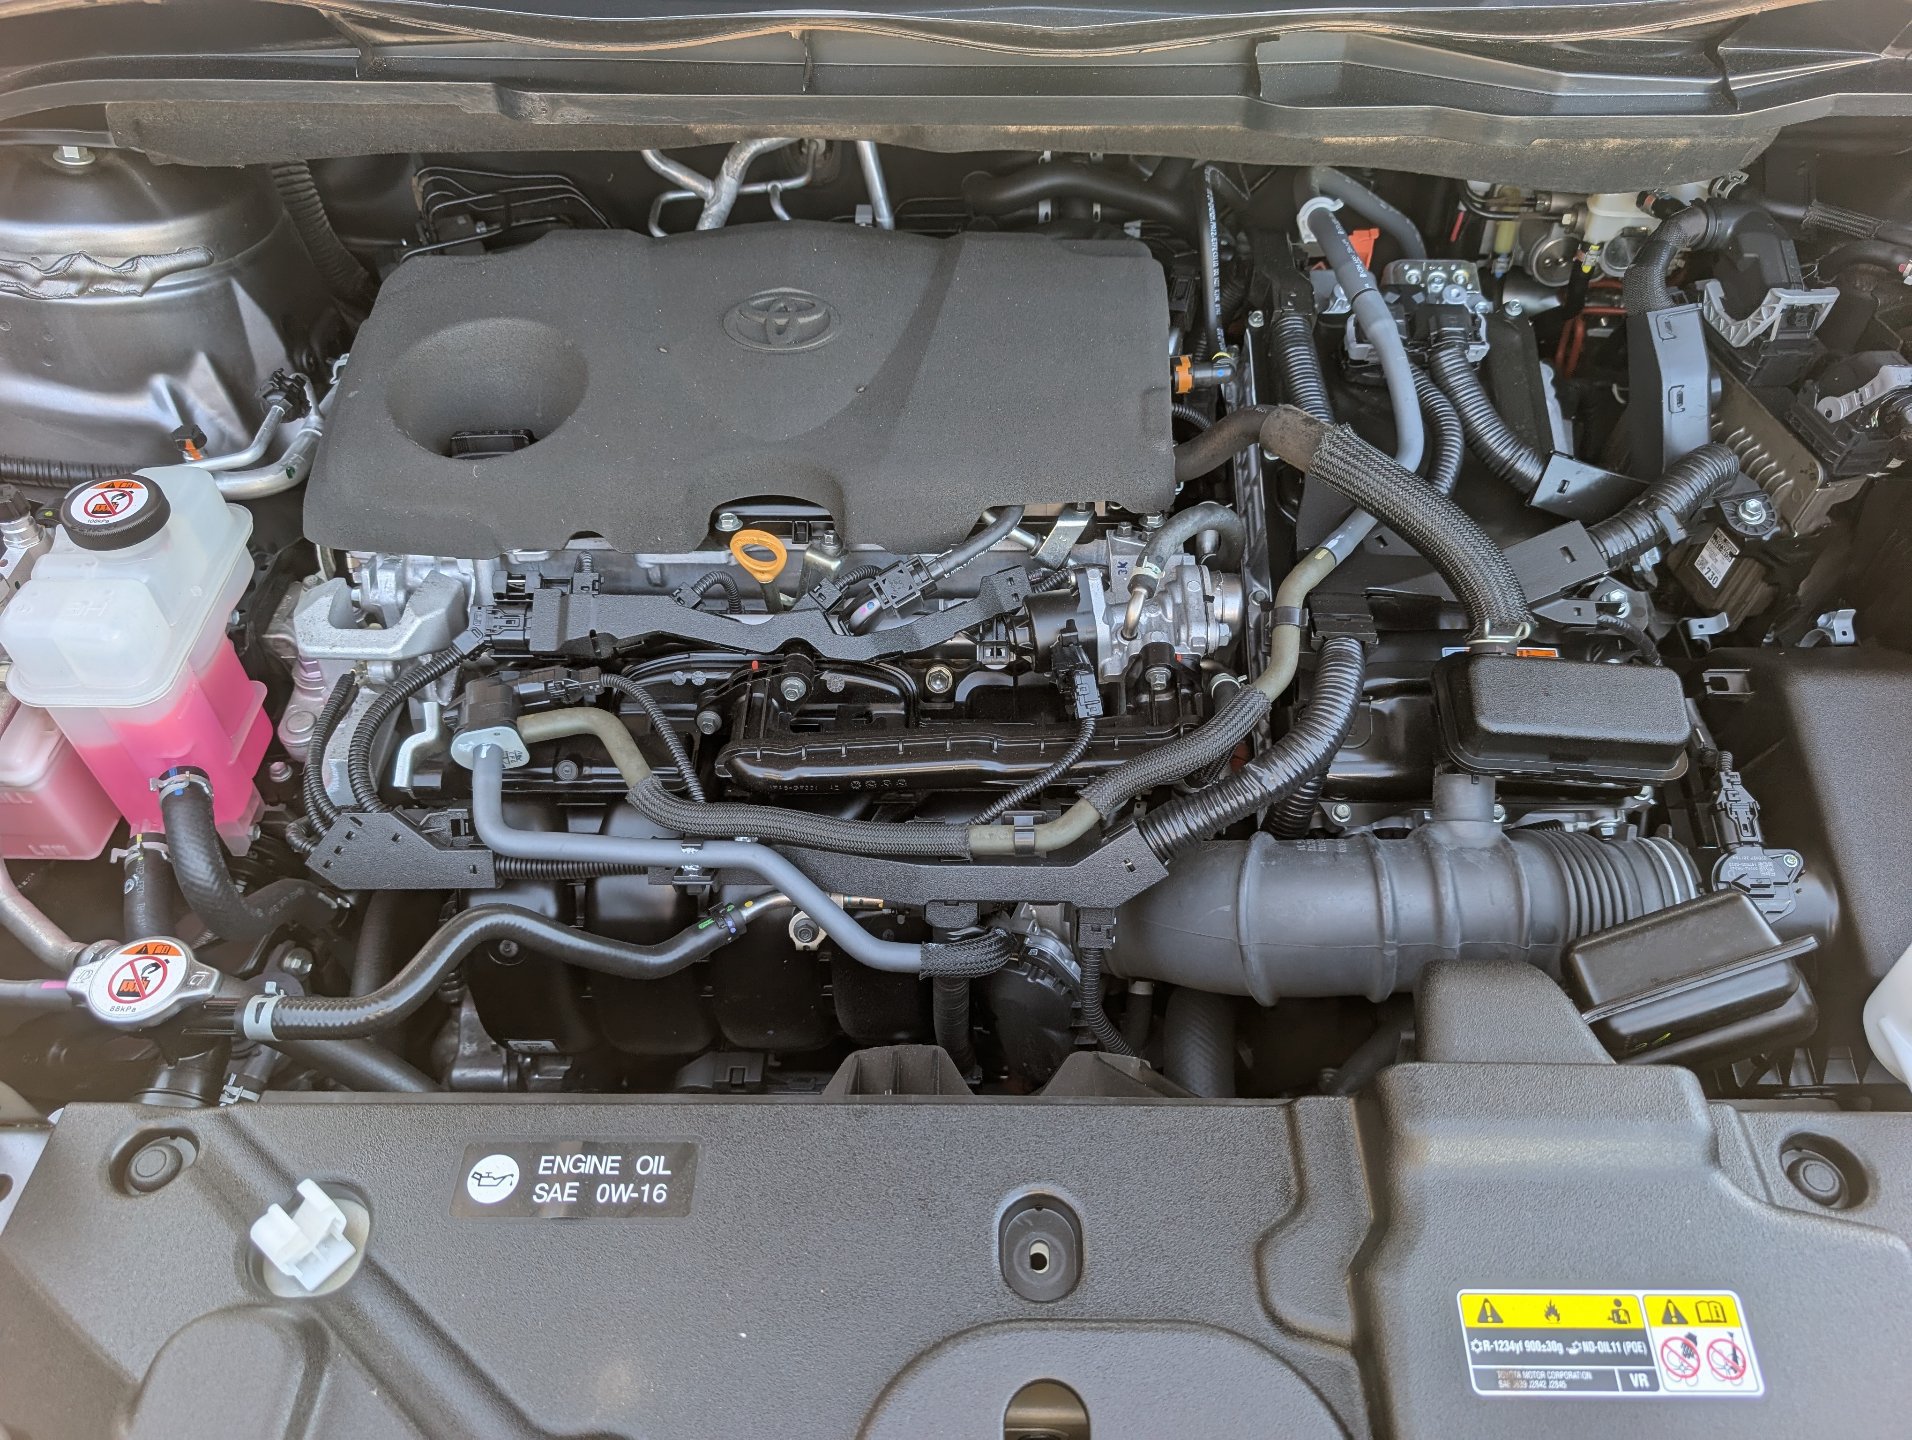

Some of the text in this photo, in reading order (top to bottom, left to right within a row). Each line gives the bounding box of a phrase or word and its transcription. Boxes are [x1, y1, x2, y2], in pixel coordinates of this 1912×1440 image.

[1704, 567, 1718, 584] 730
[109, 1005, 137, 1013] 88kPa
[538, 1154, 672, 1176] ENGINE OIL
[532, 1182, 668, 1203] SAE 0W-16
[1482, 1339, 1523, 1355] R-1234yf
[1582, 1340, 1622, 1354] ND-OIL11
[1622, 1340, 1648, 1356] (POE)
[1522, 1370, 1546, 1380] MOTOR
[1546, 1370, 1593, 1381] CORPORATION
[1628, 1373, 1651, 1388] VR
